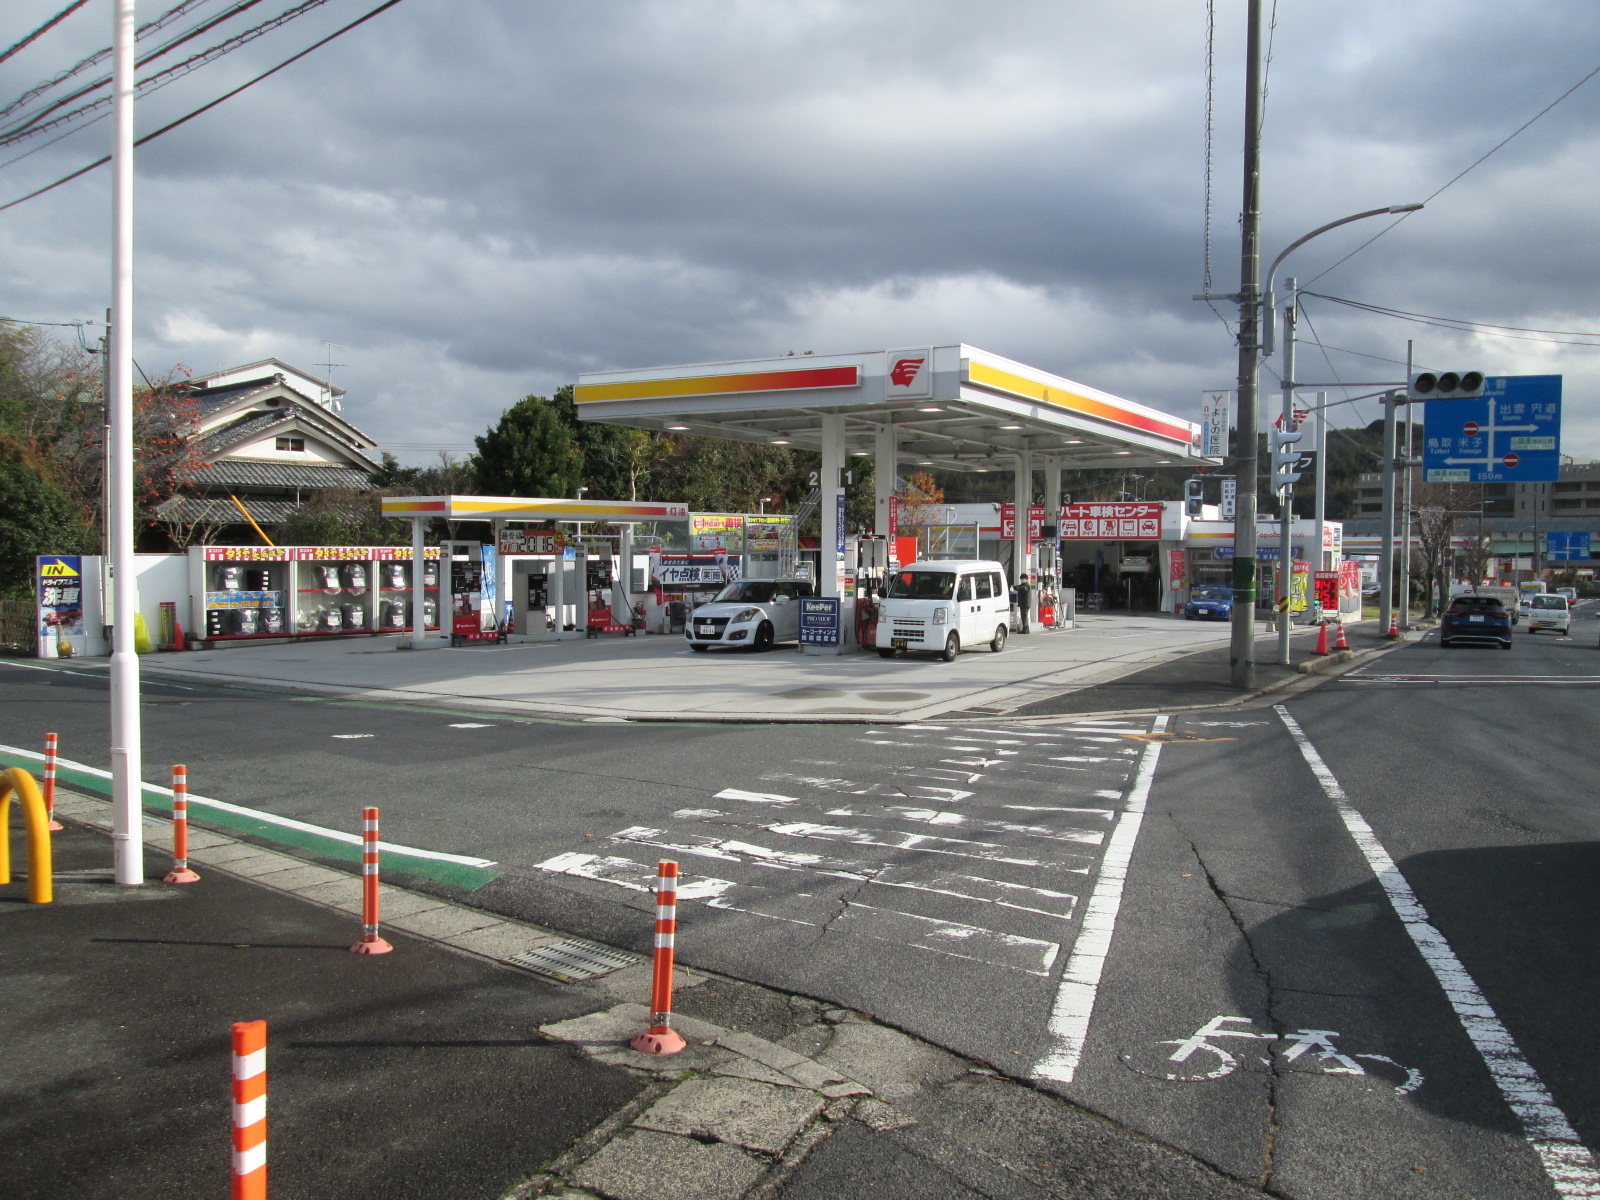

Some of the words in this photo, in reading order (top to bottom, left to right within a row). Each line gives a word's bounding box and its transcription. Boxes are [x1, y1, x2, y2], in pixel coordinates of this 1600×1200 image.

[1500, 403, 1525, 414] 出雲
[1531, 403, 1556, 414] 宍道
[1209, 408, 1221, 455] よしの医院
[1427, 437, 1452, 448] 鳥取
[1457, 437, 1483, 448] 米子
[809, 472, 818, 486] 2
[845, 471, 852, 485] 1
[1477, 472, 1503, 480] 150m
[1064, 493, 1071, 505] 3
[670, 506, 686, 517] 灯油
[1061, 506, 1158, 518] ハート車検センター
[501, 531, 522, 540] 最安値
[501, 542, 518, 553] 灯油
[46, 566, 65, 575] IN
[660, 567, 701, 582] イヤ点検
[1291, 575, 1301, 605] クルマ
[42, 587, 80, 605] 洗車
[806, 602, 833, 612] KeePer
